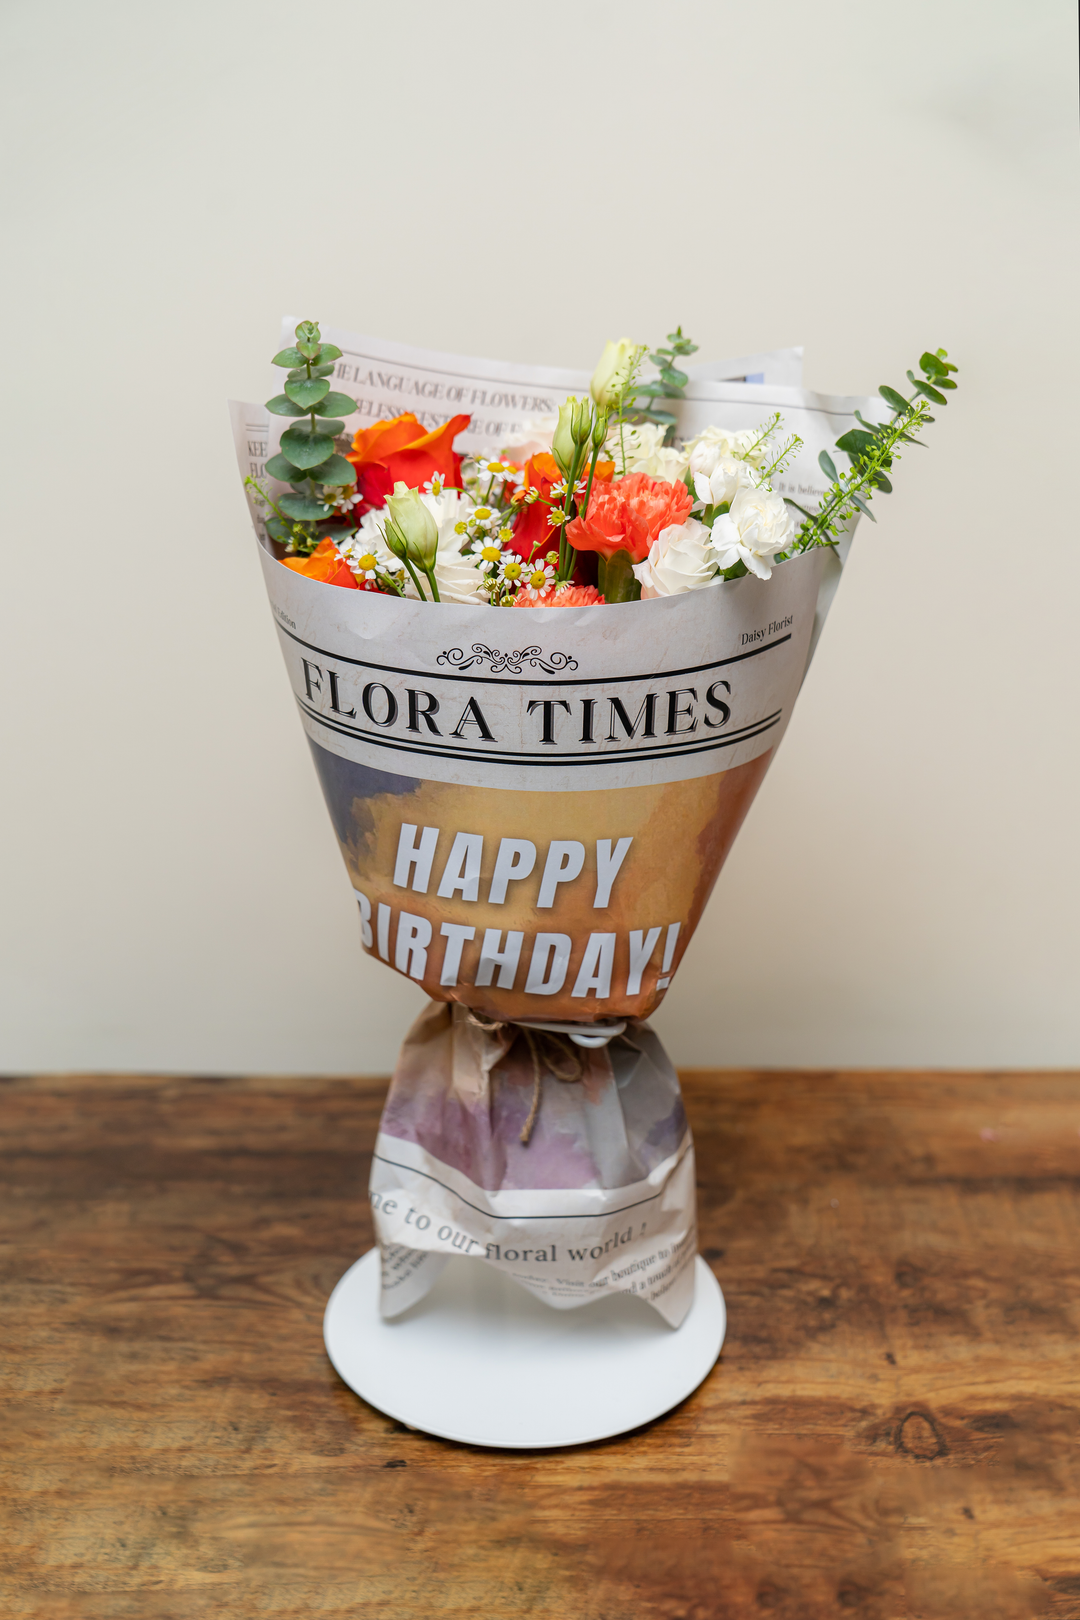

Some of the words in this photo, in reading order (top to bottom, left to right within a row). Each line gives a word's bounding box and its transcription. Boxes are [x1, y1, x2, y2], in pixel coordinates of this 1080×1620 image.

[331, 362, 351, 381] HE
[353, 366, 445, 400] LANGUAGE
[446, 386, 468, 402] OF
[741, 629, 767, 645] Daisy
[768, 614, 793, 635] Florist
[300, 657, 498, 743] FLORA
[526, 680, 732, 745] TIMES
[393, 823, 634, 909] HAPPY
[353, 887, 682, 999] BIRTHDAY!
[404, 1206, 431, 1231] to
[437, 1225, 480, 1254] our
[484, 1243, 557, 1262] floral
[567, 1226, 633, 1261] world
